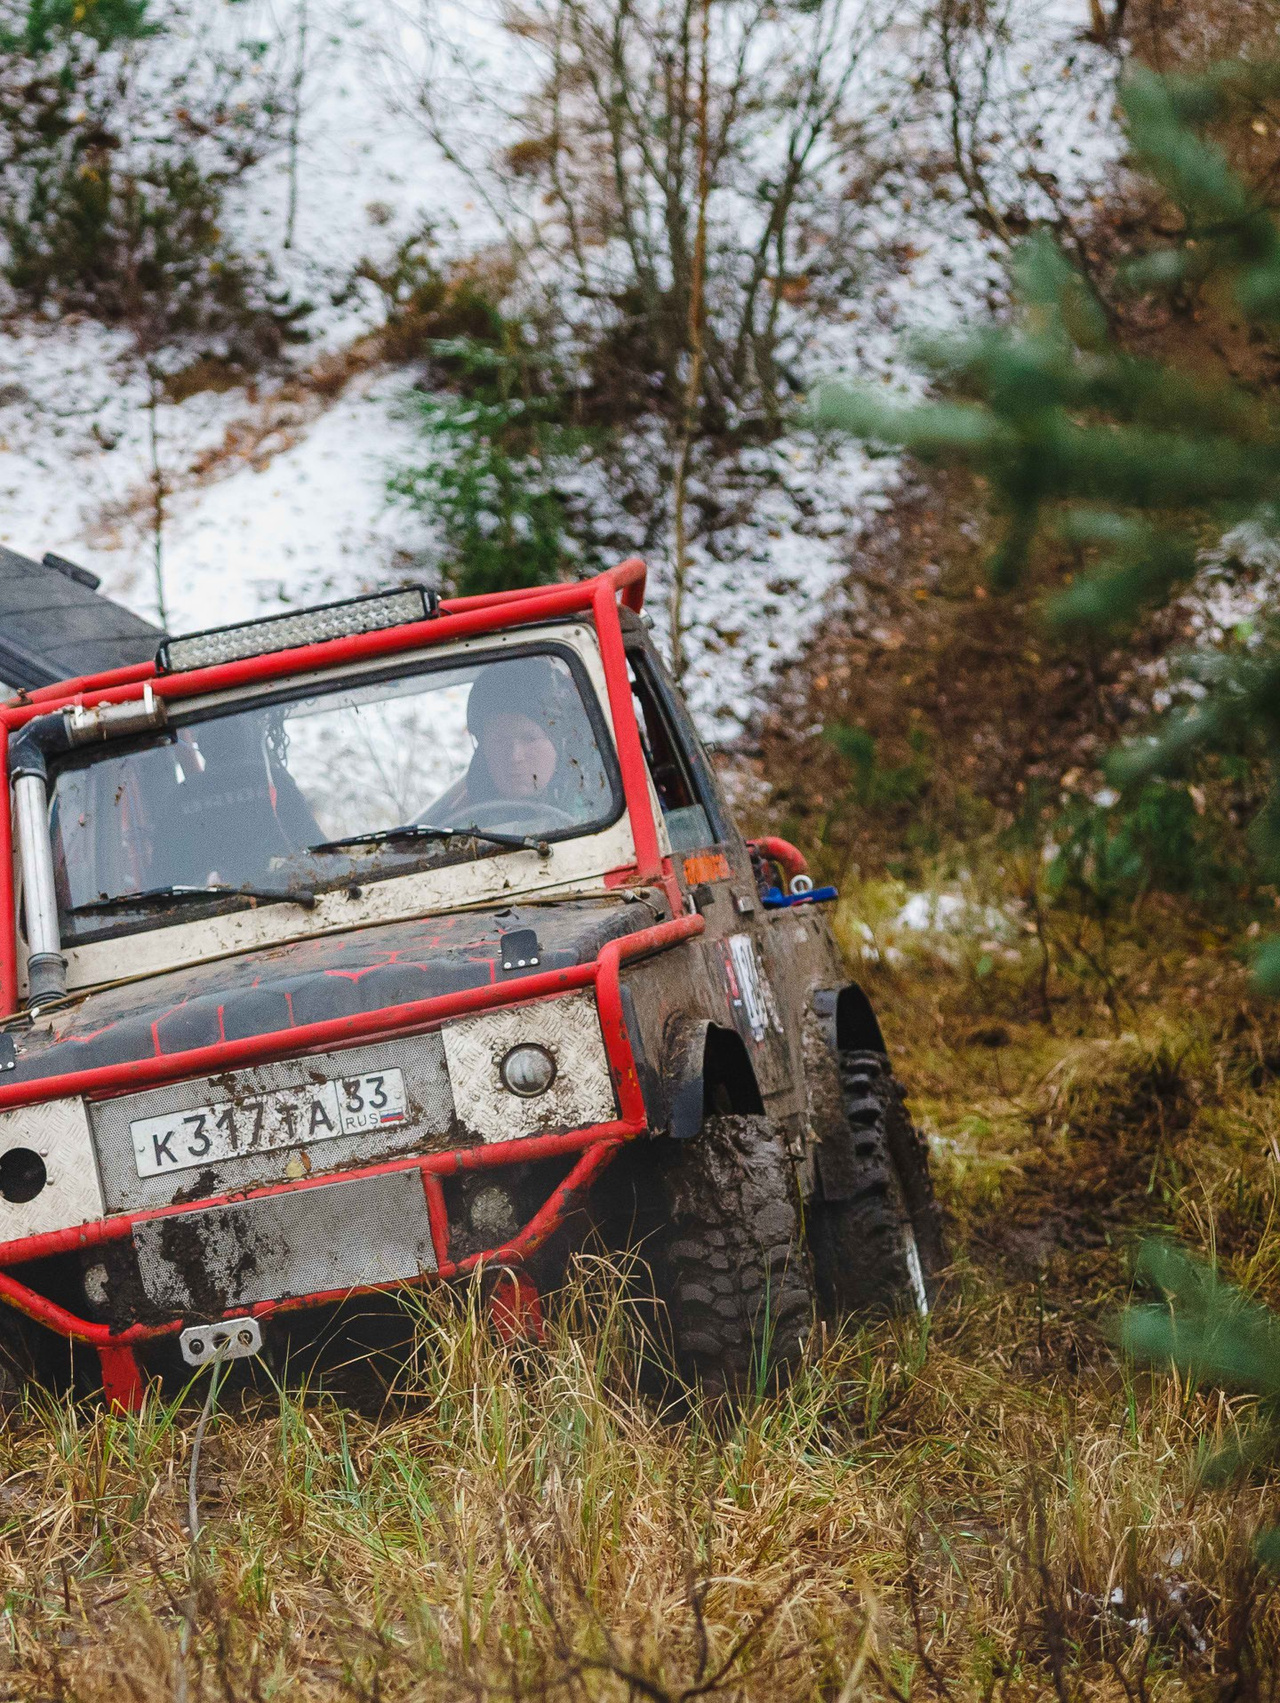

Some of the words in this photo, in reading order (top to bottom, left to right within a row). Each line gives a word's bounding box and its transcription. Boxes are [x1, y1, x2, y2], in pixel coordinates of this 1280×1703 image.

[151, 1099, 335, 1167] К317ТА
[341, 1075, 388, 1113] 33
[345, 1113, 380, 1129] RUS
